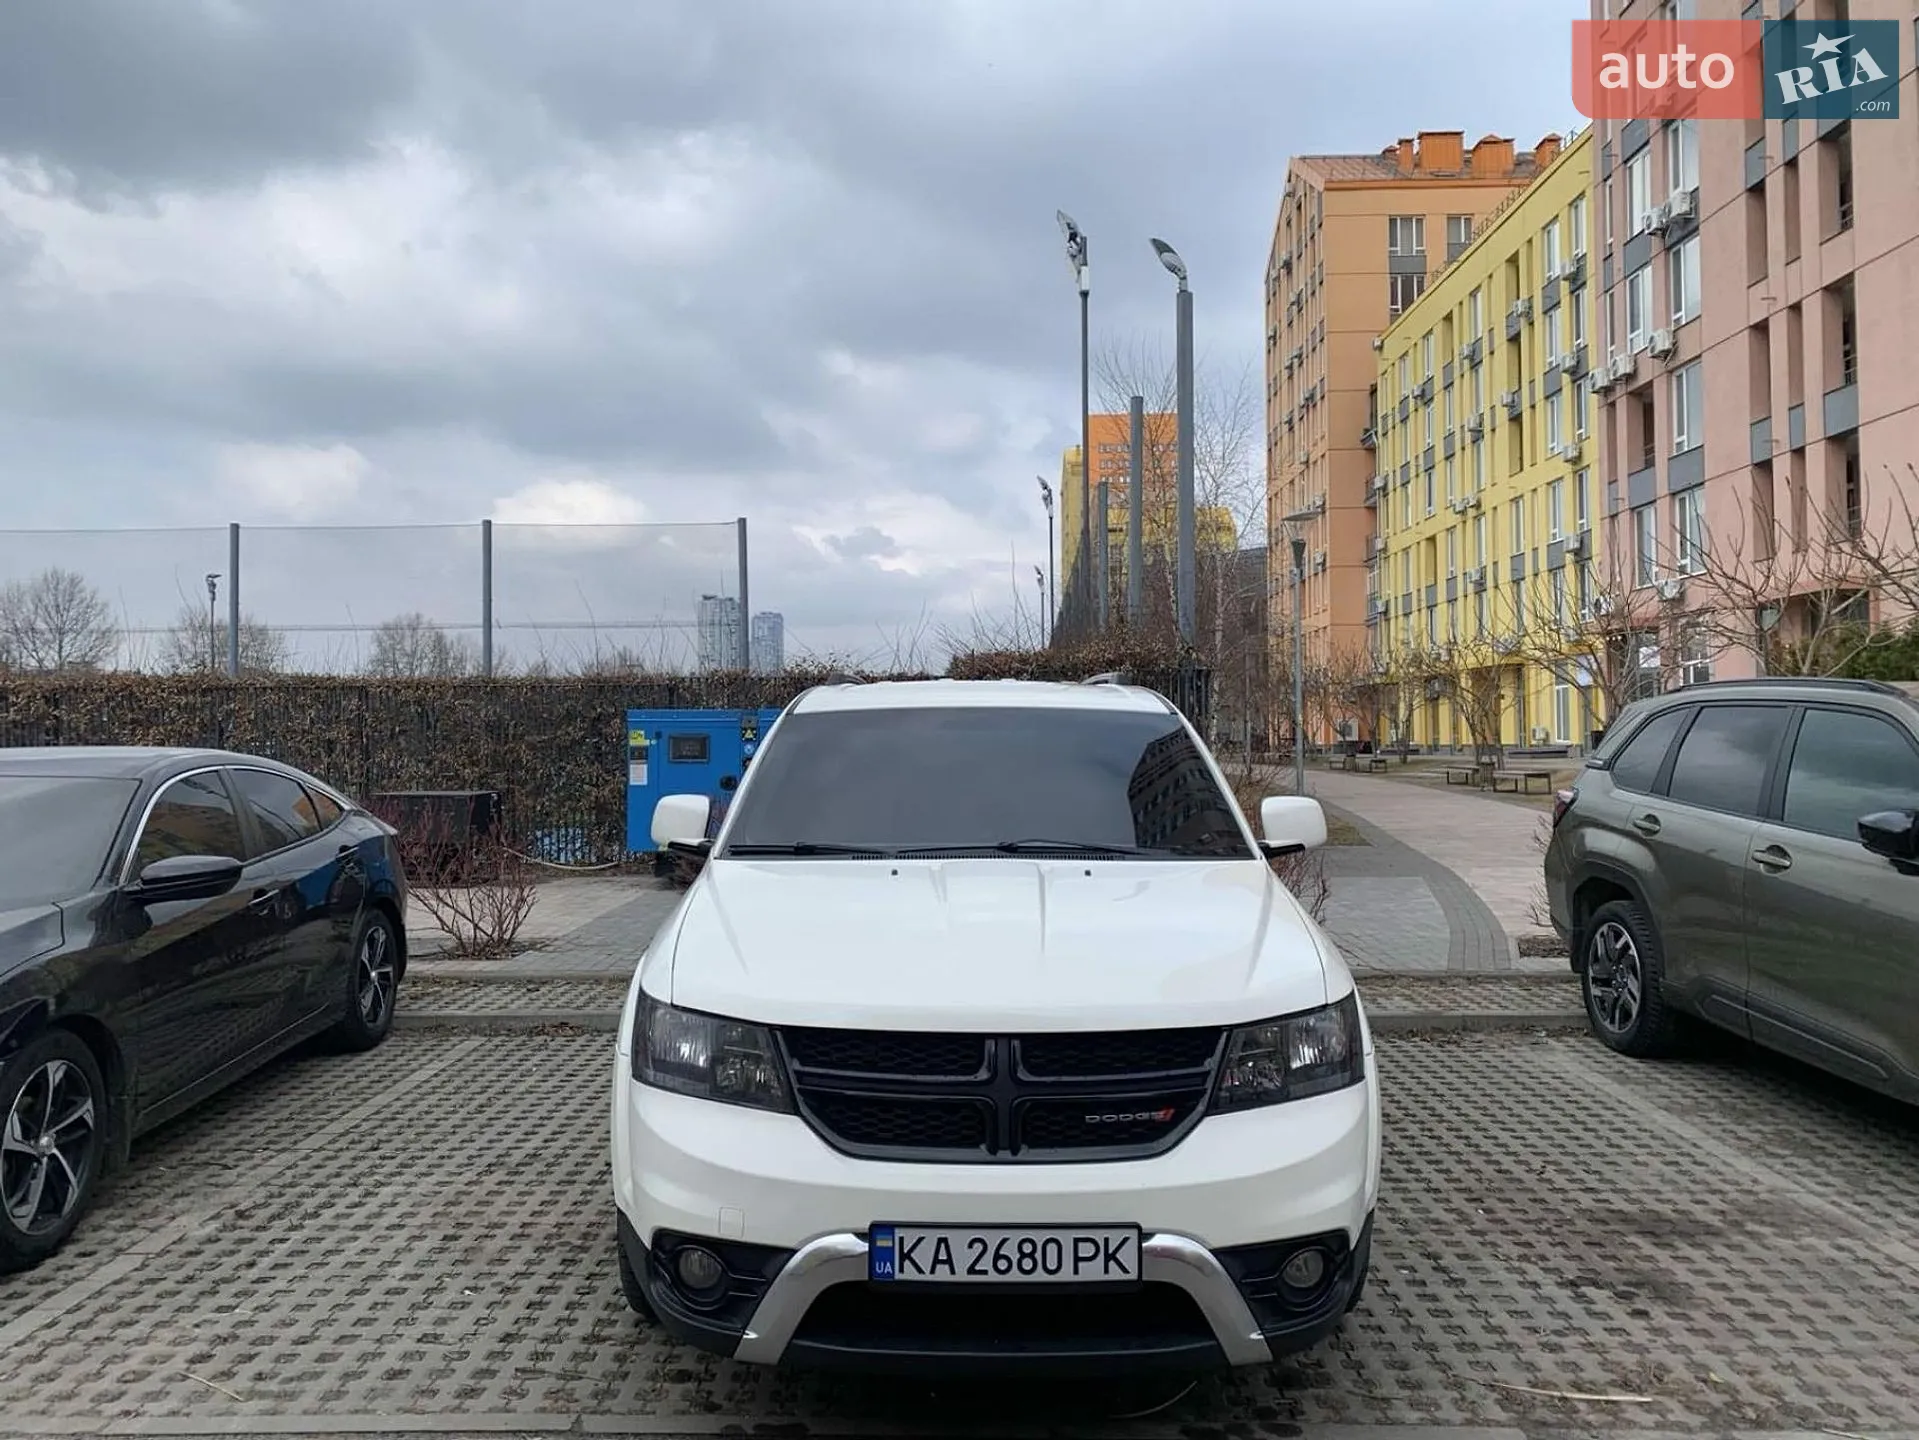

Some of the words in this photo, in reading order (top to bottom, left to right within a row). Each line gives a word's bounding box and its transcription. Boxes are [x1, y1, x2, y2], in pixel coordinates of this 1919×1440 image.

[1085, 1112, 1157, 1123] DODGE
[898, 1236, 956, 1275] KA
[966, 1237, 1063, 1276] 2680
[1072, 1236, 1131, 1276] PK
[875, 1262, 893, 1274] UA
